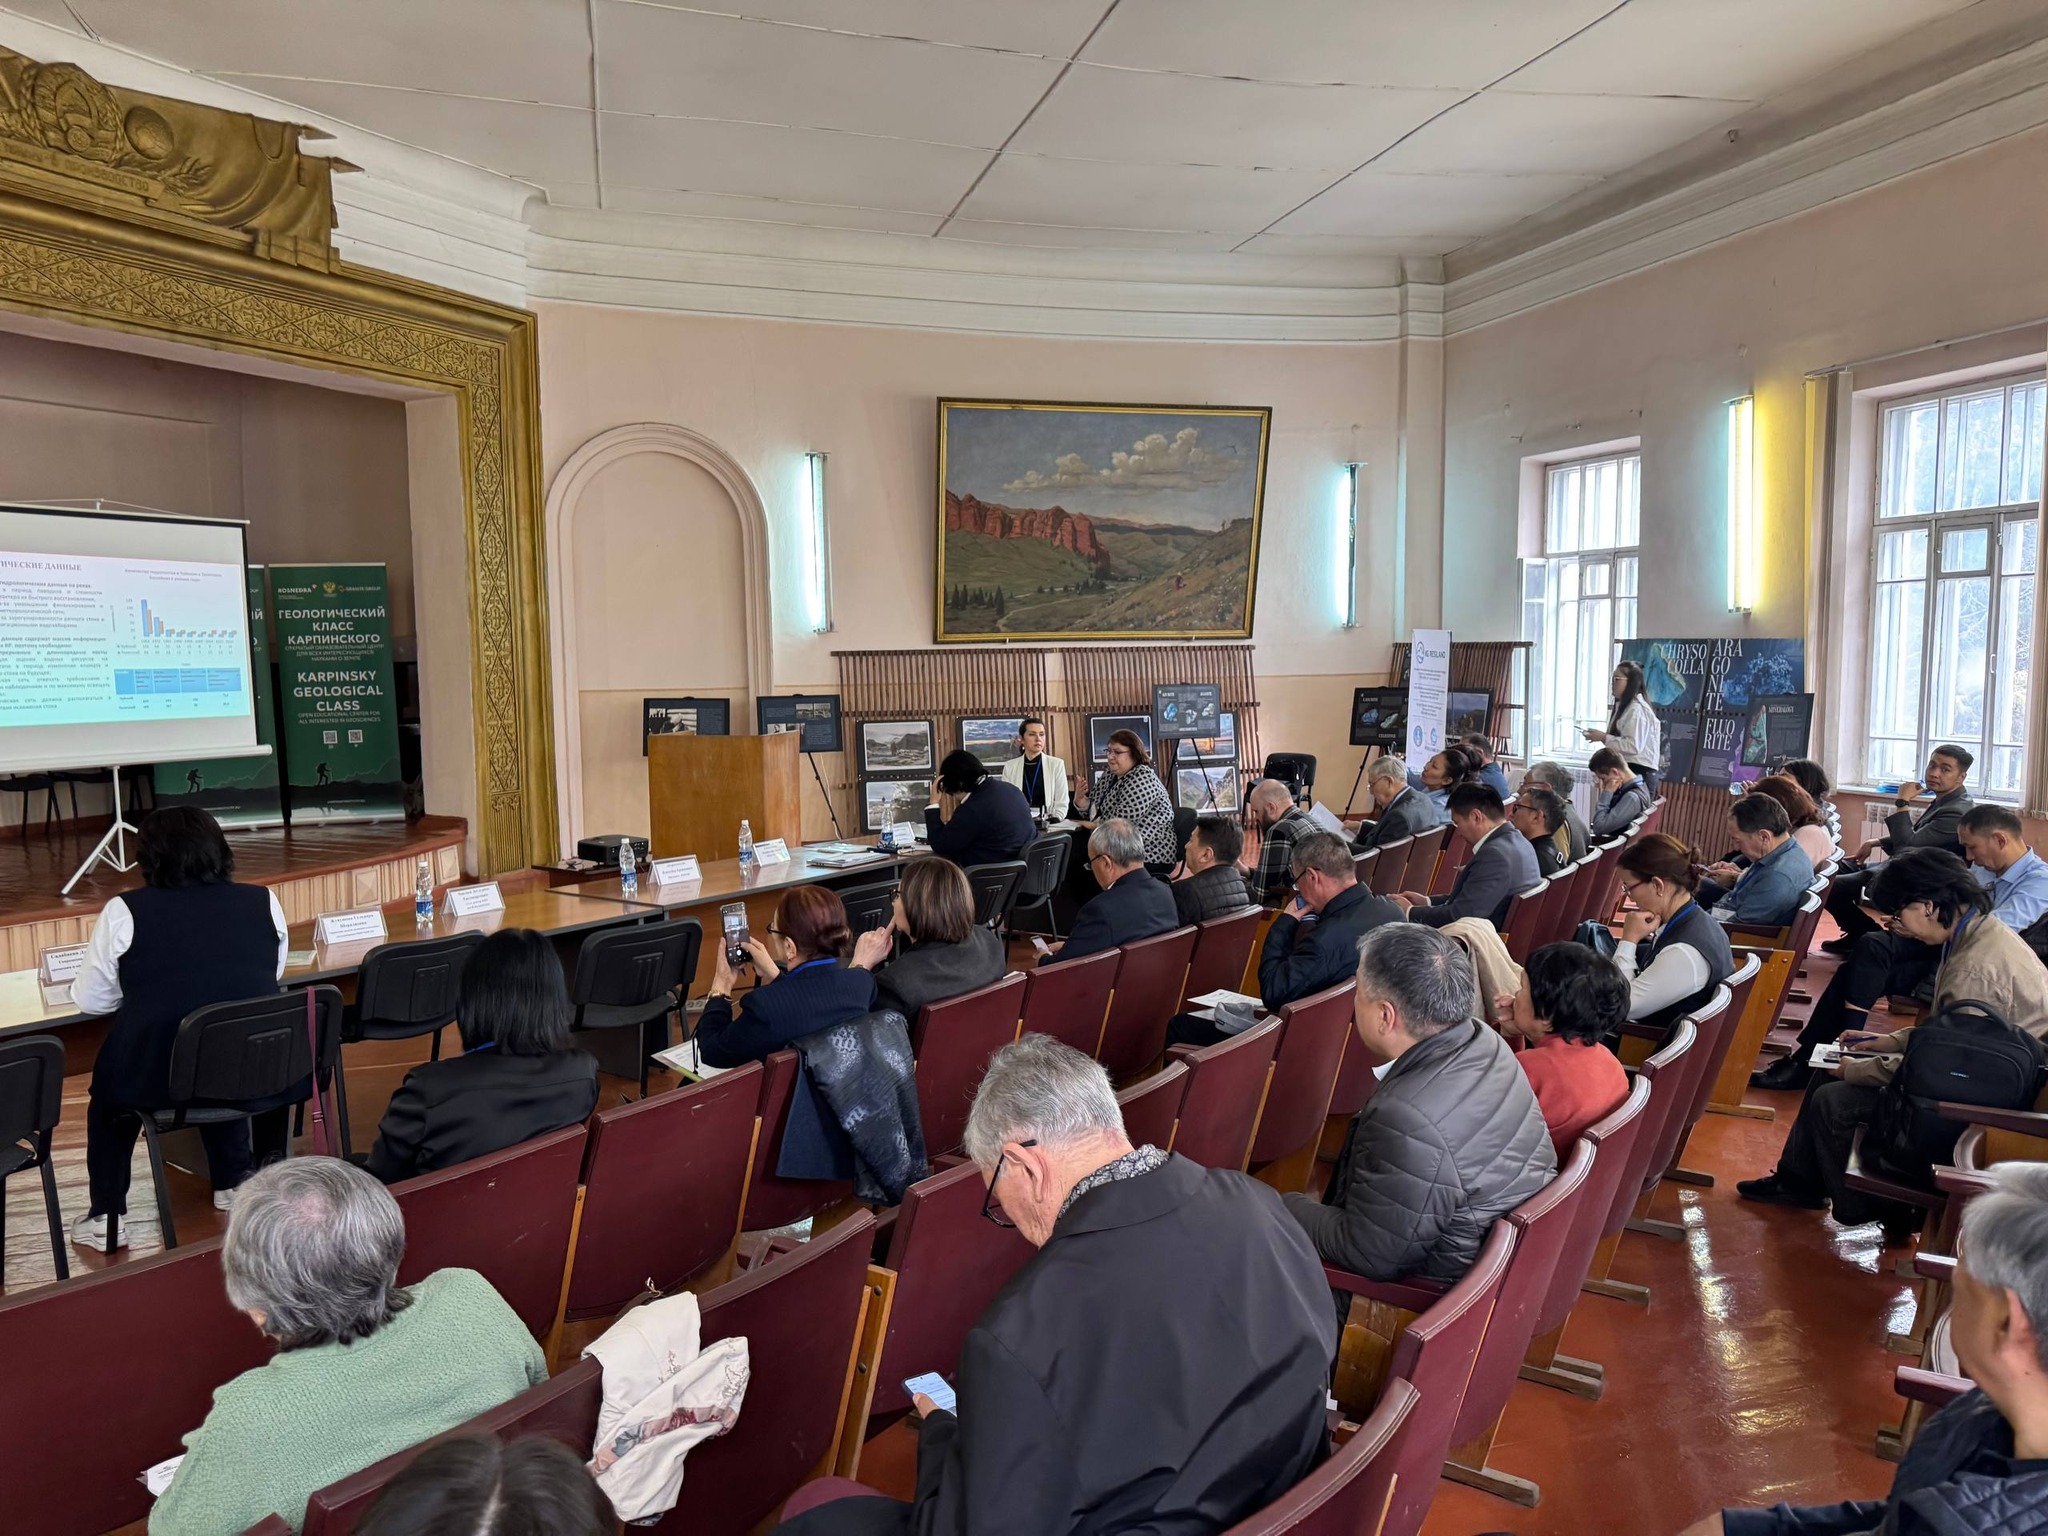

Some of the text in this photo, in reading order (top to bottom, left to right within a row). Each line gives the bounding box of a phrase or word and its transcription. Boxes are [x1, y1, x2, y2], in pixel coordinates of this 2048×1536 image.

[45, 562, 81, 571] ДАННЫЕ
[278, 606, 385, 619] ГЕОЛОГИЧЕСКИЙ
[313, 622, 354, 631] КЛАСС
[288, 634, 380, 645] КАРПИНСКОГО
[1660, 643, 1707, 660] CHRYSO
[1713, 639, 1743, 657] ARA
[1667, 659, 1704, 675] COLLA
[1711, 656, 1730, 675] GO
[297, 671, 376, 682] KARPINSKY
[1707, 675, 1724, 693] NI
[293, 686, 383, 697] GEOLOGICAL
[316, 701, 360, 711] CLASS
[1706, 692, 1723, 711] TE
[1705, 718, 1736, 736] FLUO
[1703, 734, 1732, 751] RITE
